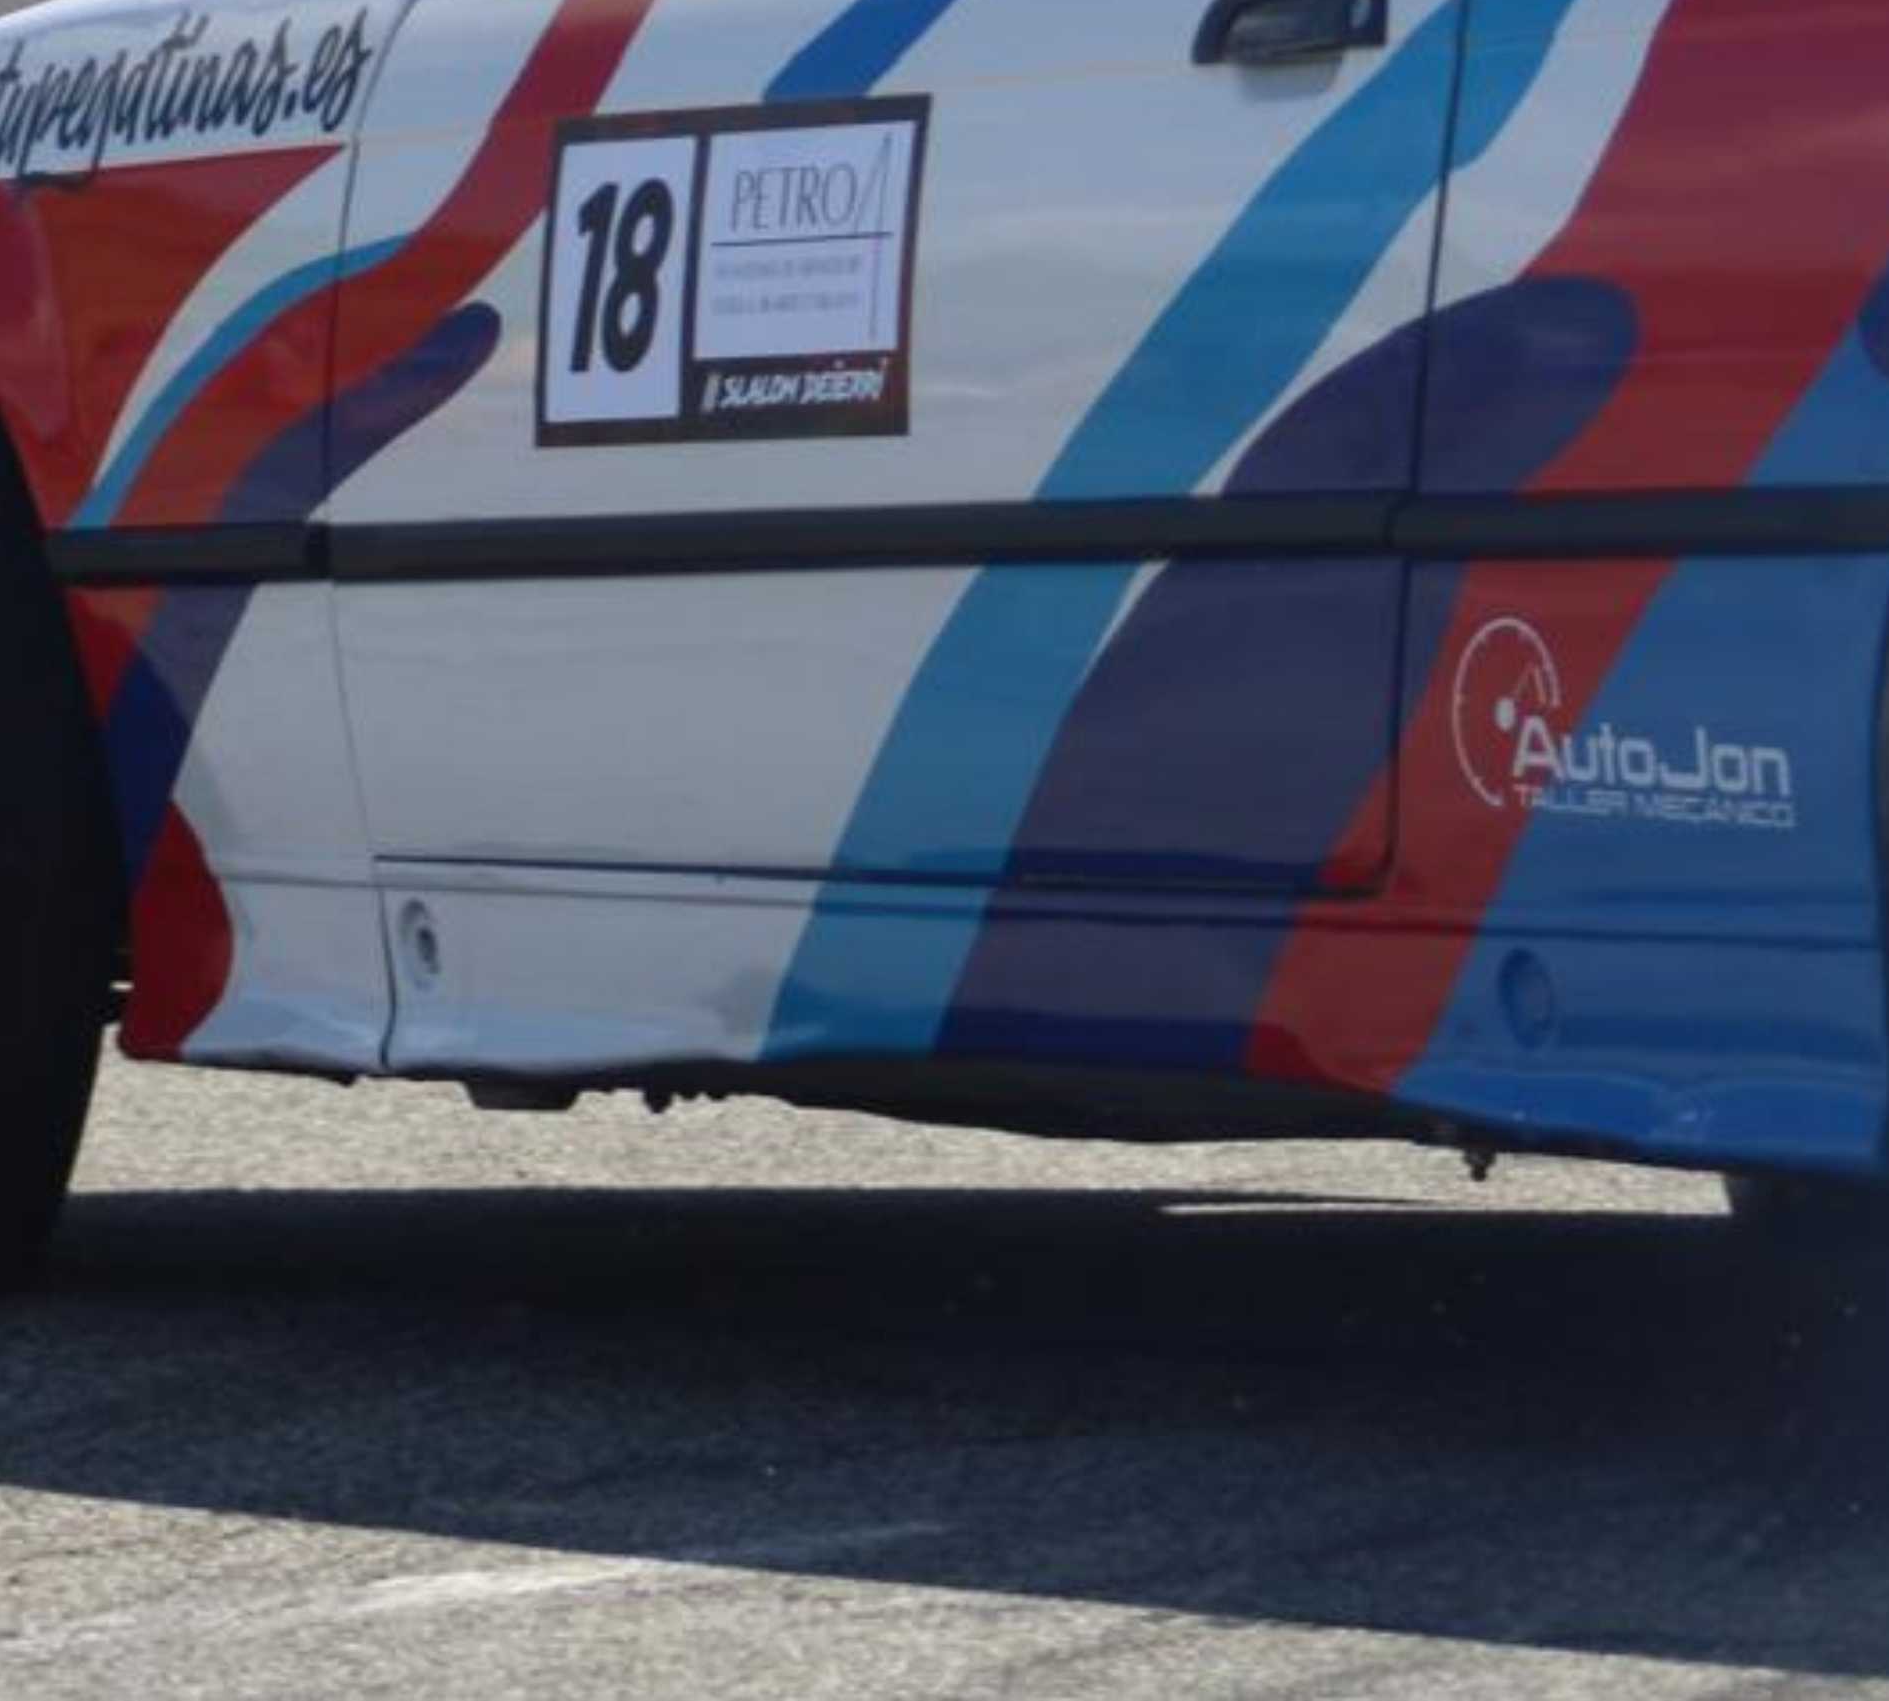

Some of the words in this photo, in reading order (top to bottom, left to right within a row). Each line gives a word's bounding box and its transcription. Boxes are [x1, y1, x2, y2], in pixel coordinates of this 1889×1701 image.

[730, 162, 858, 232] PETRO
[569, 177, 674, 374] 18
[1512, 714, 1792, 797] AutoJon
[1512, 783, 1628, 818] TALLER
